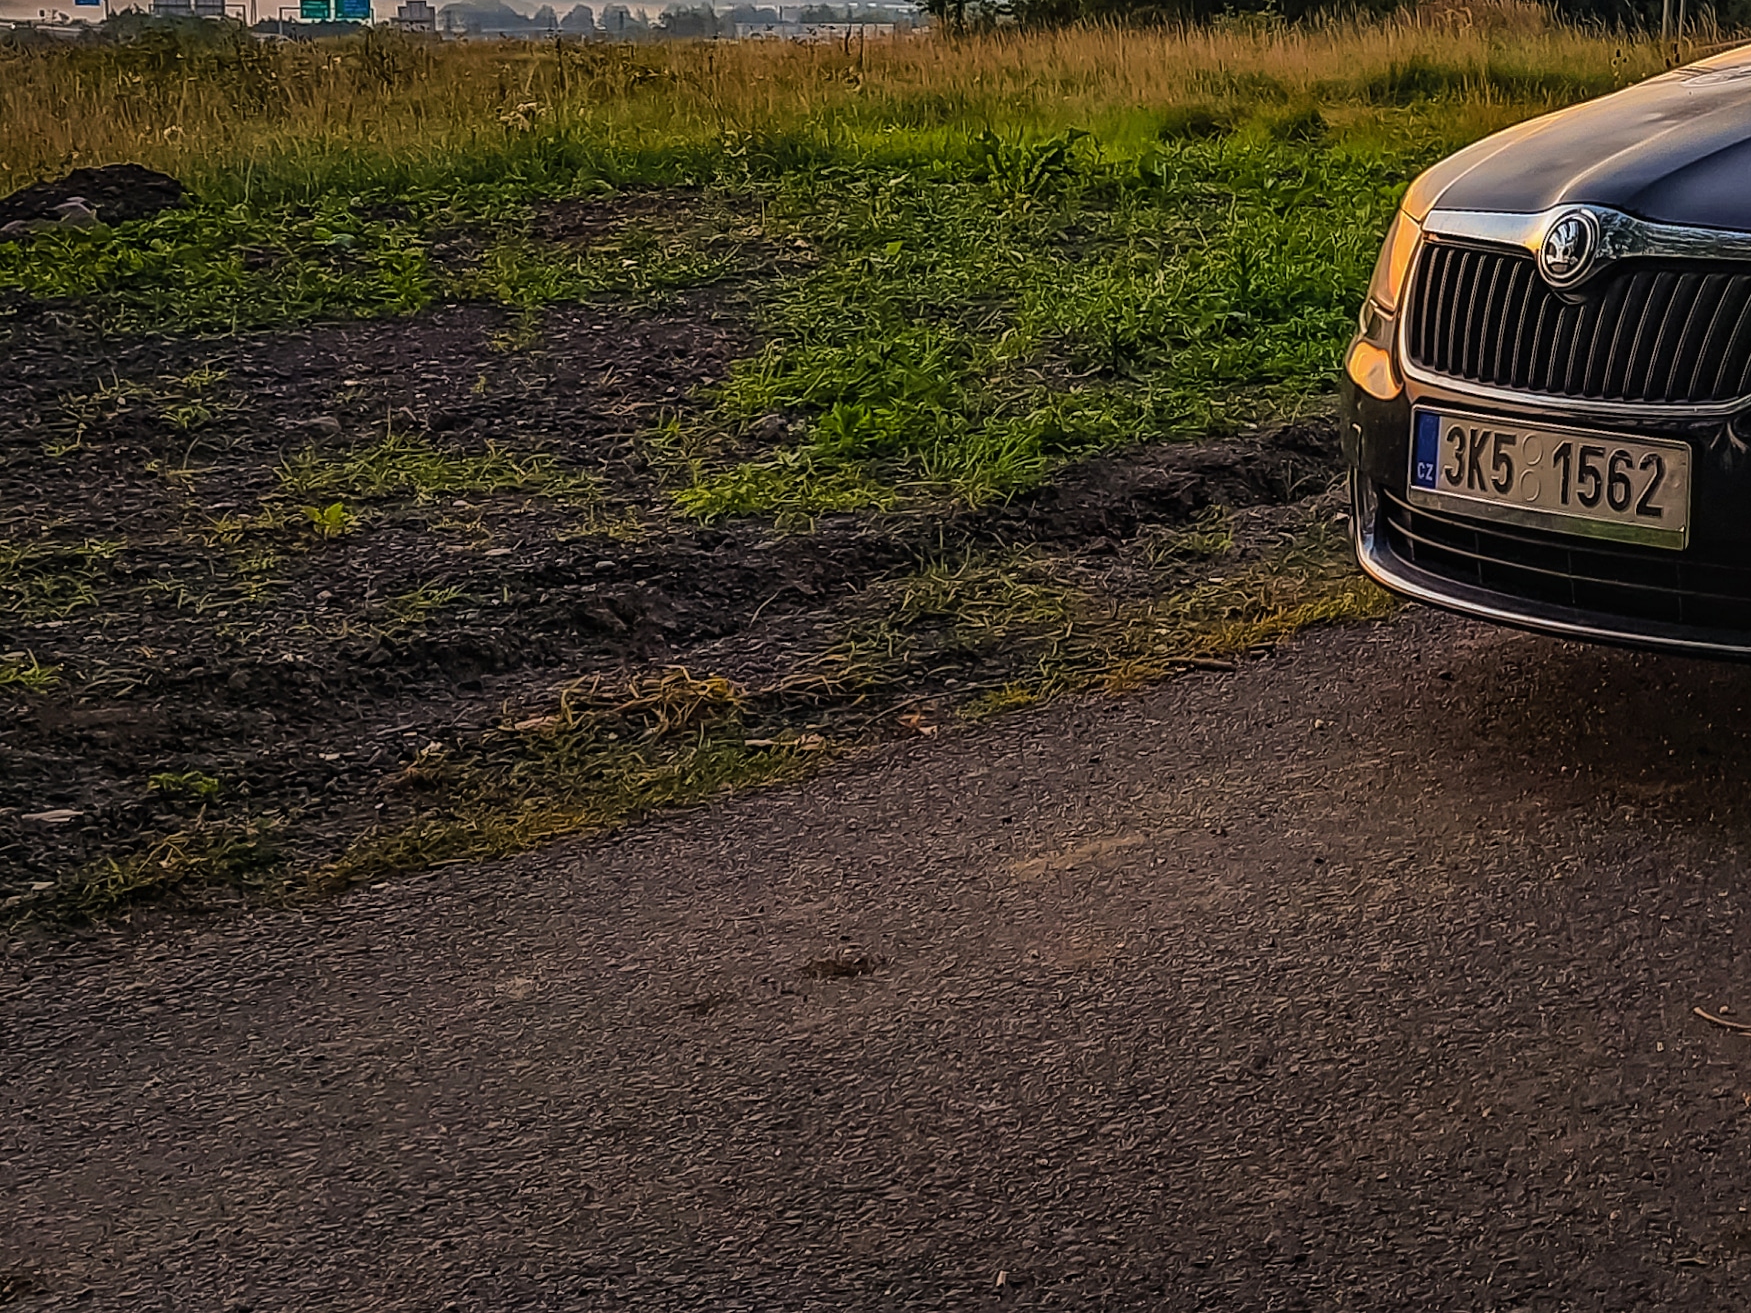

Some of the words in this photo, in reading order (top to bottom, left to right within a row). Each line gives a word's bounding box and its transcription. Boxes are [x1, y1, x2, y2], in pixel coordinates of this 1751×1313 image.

[1416, 461, 1435, 482] CZ
[1443, 424, 1517, 495] 3K5
[1552, 439, 1667, 519] 1562
